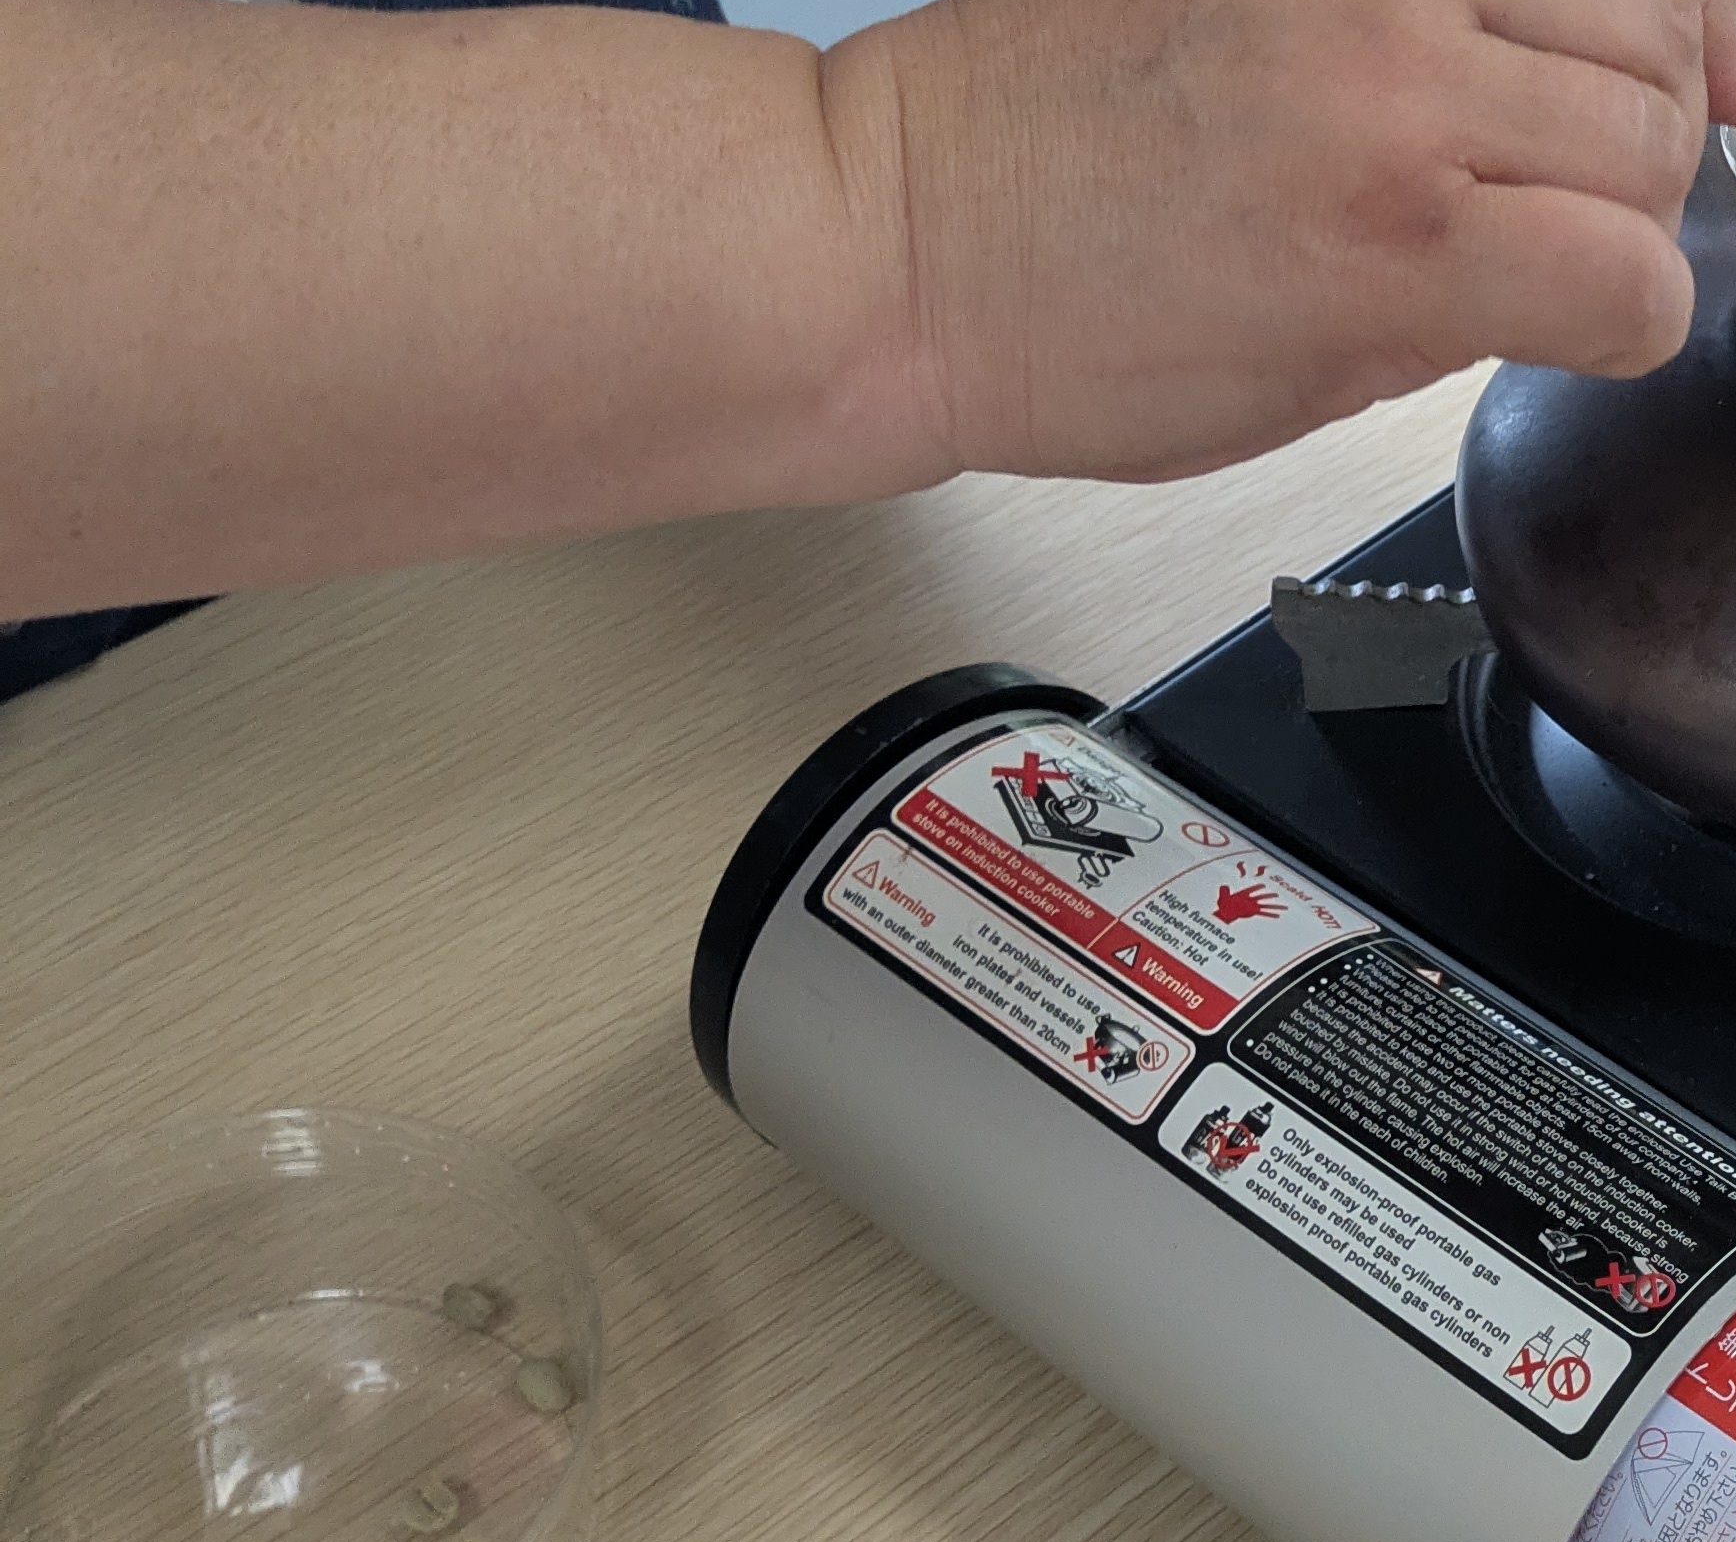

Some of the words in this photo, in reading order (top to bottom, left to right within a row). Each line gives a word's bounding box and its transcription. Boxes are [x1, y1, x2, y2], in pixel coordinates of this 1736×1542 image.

[873, 876, 937, 930] Warning
[911, 810, 948, 839] stove
[943, 834, 963, 851] on
[960, 844, 1020, 889] induction
[1014, 882, 1061, 917] cooker
[923, 798, 939, 812] It
[933, 805, 951, 820] is
[944, 813, 1011, 863] prohibited
[1005, 854, 1025, 870] to
[1019, 865, 1045, 886] use
[1040, 879, 1097, 921] portable
[1155, 889, 1191, 916] High
[1186, 909, 1238, 945] furnace
[840, 885, 869, 911] with
[865, 906, 884, 923] an
[881, 915, 917, 945] outer
[913, 937, 968, 981] diameter
[962, 973, 1011, 1013] greater
[1007, 1003, 1039, 1031] than
[1035, 1023, 1073, 1055] 20cm
[951, 935, 980, 960] iron
[974, 952, 1017, 988] plates
[1013, 978, 1041, 1002] and
[1037, 995, 1088, 1035] vessels
[976, 923, 991, 937] It
[986, 930, 1004, 946] is
[997, 939, 1065, 991] prohibited
[1060, 981, 1080, 999] to
[1075, 994, 1102, 1016] use
[1137, 957, 1206, 1011] Warning
[1141, 898, 1220, 955] temperature
[1216, 947, 1234, 962] in
[1181, 944, 1210, 966] Hot
[1252, 1042, 1274, 1061] Do
[1269, 1053, 1293, 1074] not
[1285, 1066, 1323, 1097] place
[1318, 1087, 1331, 1100] it
[1326, 1093, 1343, 1108] in
[1338, 1101, 1362, 1121] the
[1357, 1114, 1393, 1143] reach
[1388, 1135, 1407, 1152] of
[1261, 1031, 1313, 1071] pressure
[1310, 1061, 1326, 1076] in
[1321, 1069, 1345, 1089] the
[1382, 1112, 1432, 1151] causing
[1313, 990, 1328, 1001] It
[1322, 996, 1338, 1008] is
[1331, 1003, 1390, 1044] prohibited
[1384, 1037, 1403, 1051] to
[1395, 1046, 1430, 1071] keep
[1424, 1064, 1452, 1084] and
[1447, 1081, 1472, 1099] use
[1468, 1094, 1493, 1111] the
[1485, 1106, 1539, 1144] portable
[1533, 1137, 1570, 1163] stove
[1564, 1159, 1585, 1174] on
[1581, 1169, 1606, 1187] the
[1601, 1182, 1658, 1222] induction
[1325, 982, 1340, 992] It
[1334, 987, 1351, 999] is
[1343, 994, 1402, 1035] prohibited
[1397, 1029, 1415, 1042] to
[1409, 1038, 1434, 1056] use
[1430, 1051, 1457, 1070] two
[1451, 1067, 1468, 1079] or
[1464, 1075, 1497, 1098] more
[1492, 1094, 1545, 1130] portable
[1539, 1124, 1582, 1153] stoves
[1575, 1149, 1622, 1181] closely
[1446, 986, 1540, 1045] Matters
[1537, 1046, 1637, 1109] needing
[1276, 1018, 1307, 1042] wind
[1302, 1036, 1325, 1055] will
[1320, 1048, 1352, 1073] blow
[1346, 1065, 1370, 1085] out
[1365, 1078, 1389, 1098] the
[1418, 1114, 1446, 1136] The
[1441, 1130, 1465, 1149] hot
[1460, 1143, 1482, 1161] air
[1476, 1153, 1500, 1173] will
[1496, 1167, 1549, 1206] increase
[1544, 1200, 1569, 1220] the
[1564, 1213, 1586, 1231] air
[1287, 1008, 1336, 1043] touched
[1328, 1036, 1351, 1055] by
[1390, 1077, 1414, 1095] Do
[1408, 1089, 1433, 1108] not
[1427, 1103, 1453, 1122] use
[1449, 1116, 1463, 1128] it
[1458, 1122, 1475, 1136] in
[1468, 1130, 1511, 1162] strong
[1506, 1154, 1539, 1179] wind
[1534, 1174, 1551, 1189] or
[1548, 1182, 1573, 1202] hot
[1599, 1217, 1654, 1256] because
[1647, 1250, 1692, 1283] strong
[1300, 998, 1351, 1034] because
[1345, 1028, 1370, 1047] the
[1363, 1040, 1415, 1077] accident
[1407, 1073, 1437, 1095] may
[1433, 1089, 1469, 1115] occur
[1465, 1109, 1480, 1121] if
[1474, 1114, 1499, 1133] the
[1493, 1127, 1534, 1157] switch
[1529, 1151, 1548, 1166] of
[1542, 1160, 1568, 1179] the
[1562, 1174, 1619, 1214] induction
[1613, 1208, 1659, 1241] cooker
[1654, 1235, 1671, 1249] is
[1255, 1158, 1281, 1181] Do
[1276, 1173, 1305, 1198] not
[1300, 1192, 1328, 1216] use
[1326, 1208, 1377, 1248] refilled
[1370, 1243, 1401, 1270] gas
[1397, 1260, 1466, 1314] cylinders
[1462, 1307, 1483, 1324] or
[1480, 1319, 1511, 1345] non
[1265, 1142, 1332, 1195] cylinders
[1326, 1187, 1360, 1215] may
[1358, 1205, 1381, 1226] be
[1377, 1219, 1416, 1250] used
[1278, 1126, 1317, 1159] Only
[1310, 1149, 1420, 1231] explosion-proof
[1413, 1220, 1477, 1270] portable
[1470, 1262, 1502, 1289] gas
[1241, 1175, 1311, 1231] explosion
[1305, 1220, 1349, 1258] proof
[1342, 1247, 1405, 1297] portable
[1398, 1289, 1430, 1316] gas
[1426, 1305, 1495, 1361] cylinders
